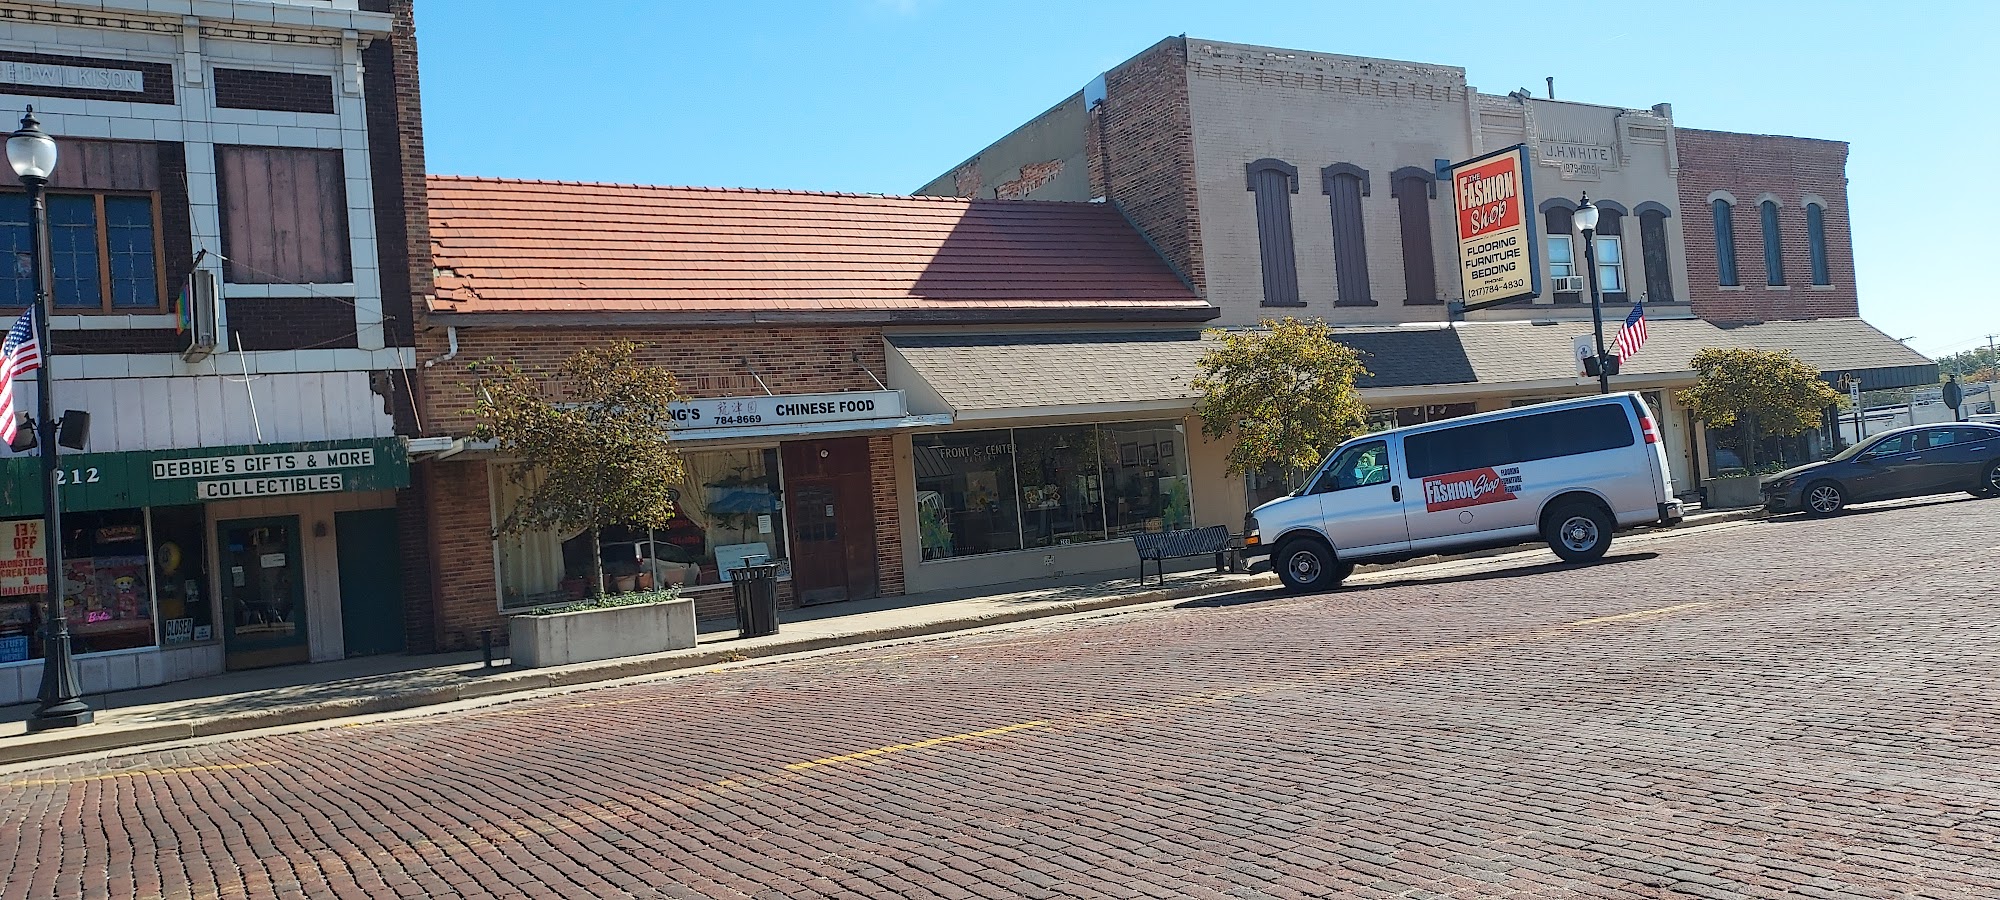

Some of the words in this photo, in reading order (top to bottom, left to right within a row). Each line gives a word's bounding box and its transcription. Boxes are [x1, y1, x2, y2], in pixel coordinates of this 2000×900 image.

[1469, 173, 1480, 182] THE
[1460, 171, 1514, 210] FASHION
[1471, 200, 1507, 234] Shop
[1467, 237, 1516, 256] FLOORING
[1466, 248, 1521, 269] FURNITURE
[1472, 262, 1516, 279] BEDDING
[1468, 279, 1524, 298] (217)784-4830
[775, 402, 835, 416] CHINESE
[839, 399, 874, 414] FOOD
[714, 415, 761, 425] 784-8669
[941, 447, 969, 458] FRONT
[974, 447, 982, 456] &
[986, 443, 1018, 455] CENTER
[154, 457, 235, 478] DEBBIE'S
[244, 455, 296, 471] GIFTS
[307, 454, 317, 467] &
[327, 451, 371, 466] MORE
[56, 467, 100, 485] 212
[207, 476, 341, 497] COLLECTIBLES
[1425, 480, 1475, 504] FASHION
[1473, 474, 1499, 499] Shop
[13, 537, 37, 550] OFF
[0, 557, 44, 568] MONSTERS
[16, 550, 31, 558] ALL
[1, 566, 48, 577] CREATURES
[23, 577, 30, 585] &
[166, 619, 193, 636] CLOSED
[0, 637, 24, 649] STUFF
